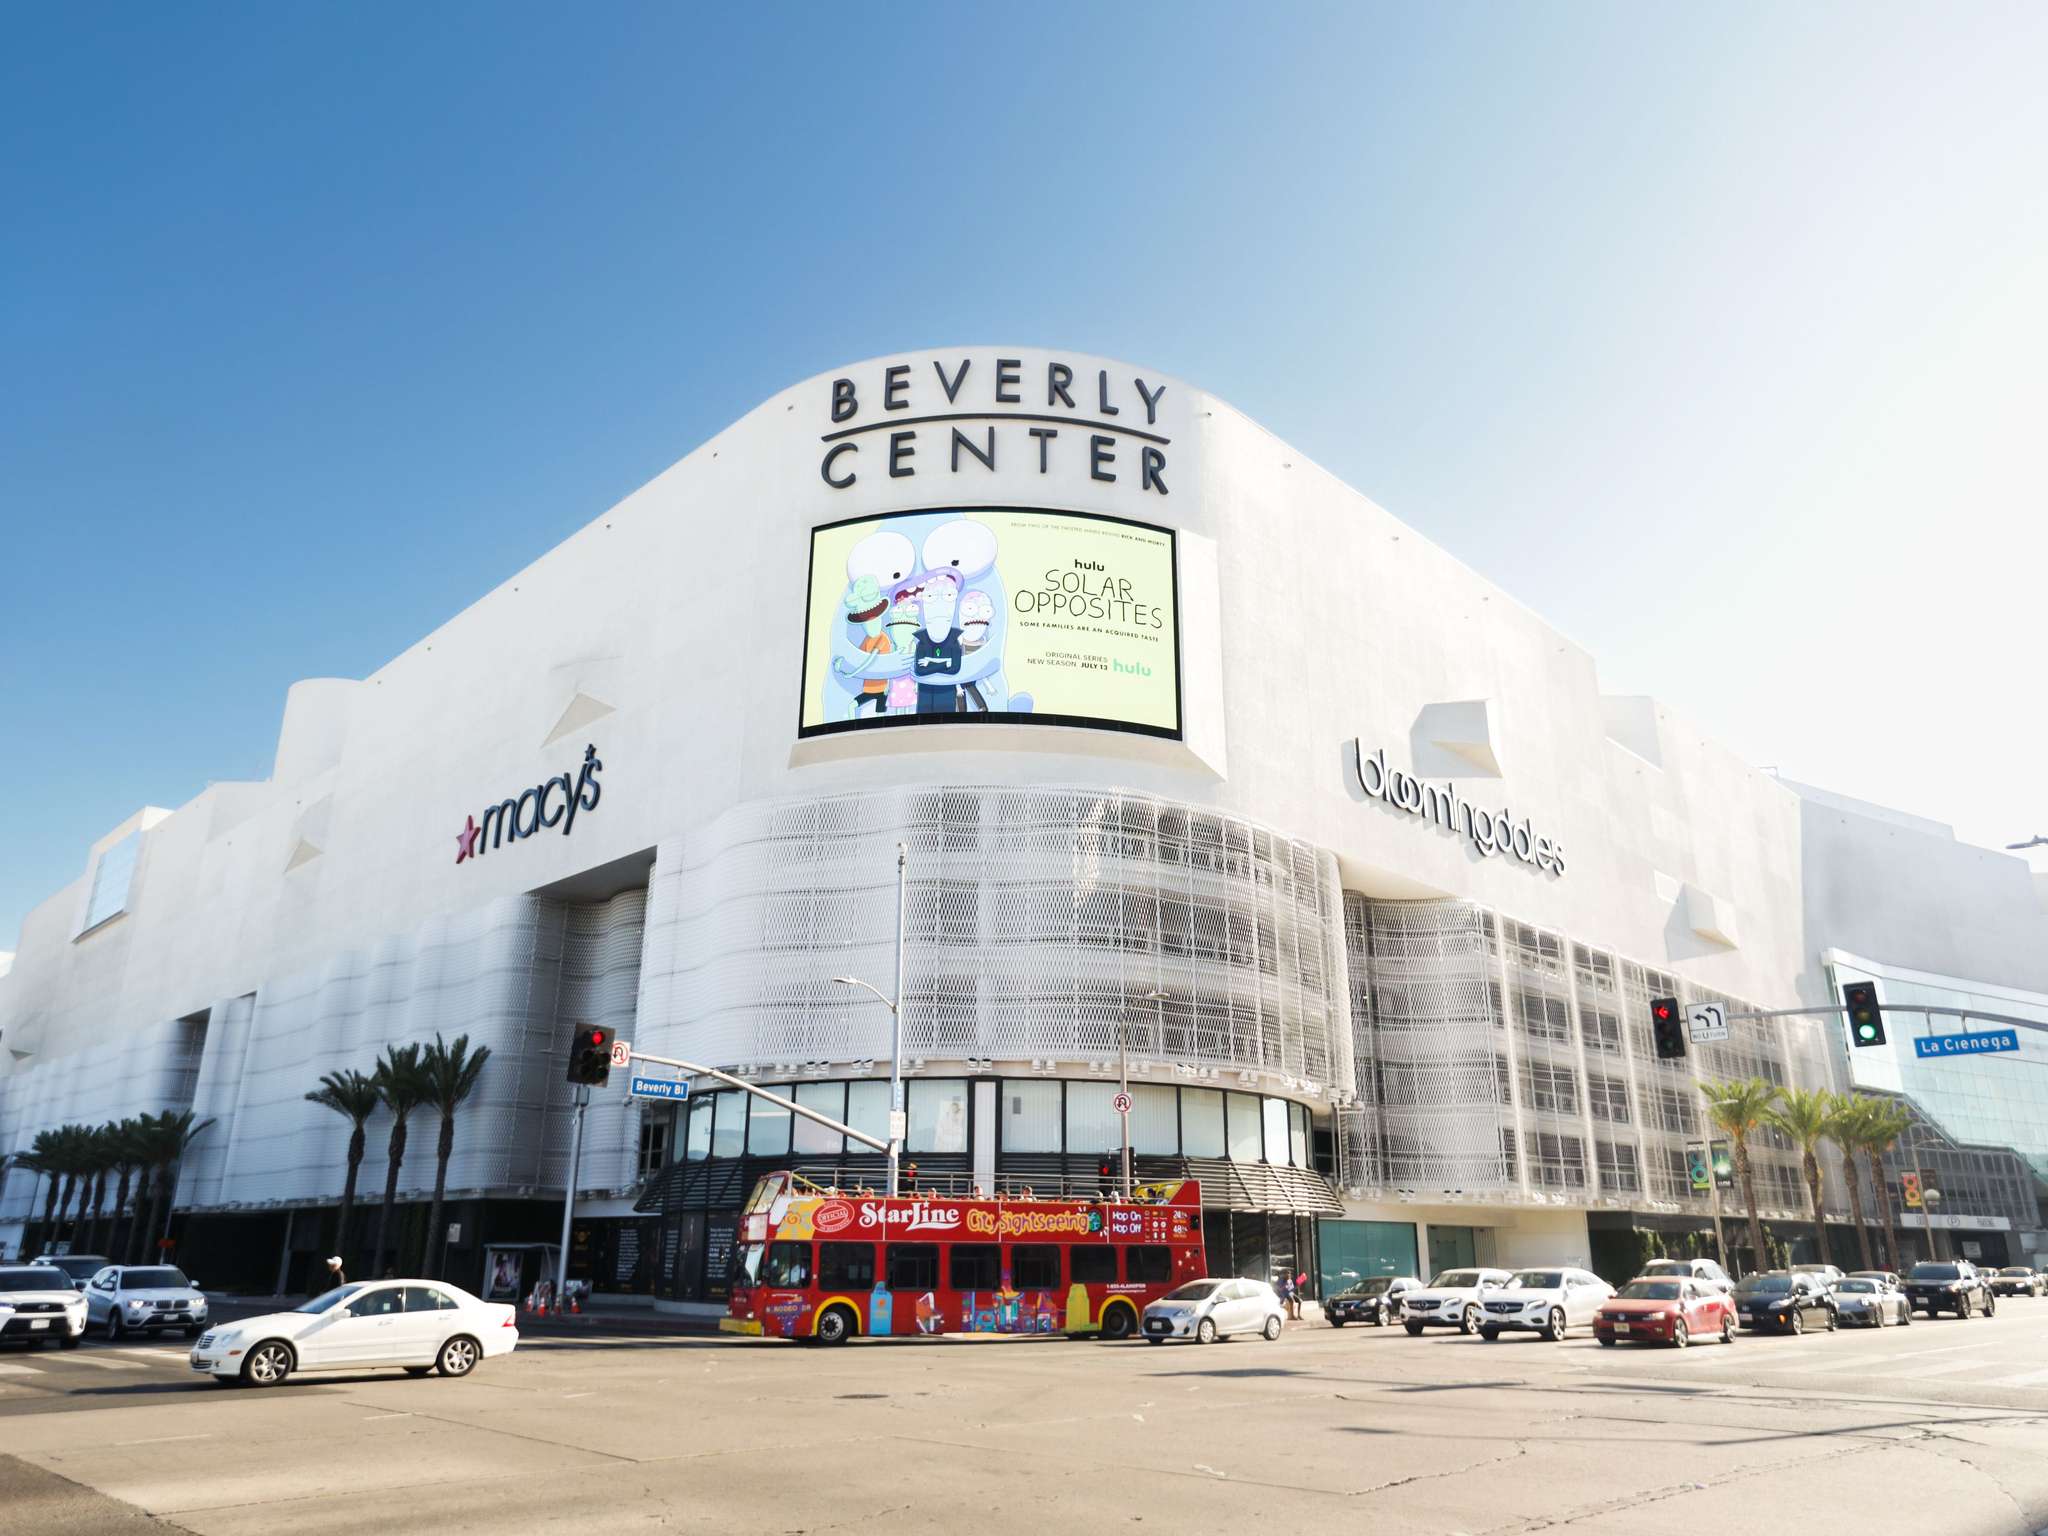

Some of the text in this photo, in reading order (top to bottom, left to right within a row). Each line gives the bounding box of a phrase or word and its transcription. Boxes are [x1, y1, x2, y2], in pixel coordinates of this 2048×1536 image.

[831, 359, 1166, 424] BEVERLY
[821, 426, 1169, 495] CENTER
[1074, 559, 1105, 571] hulu
[1045, 569, 1134, 601] SOLAR
[1015, 590, 1163, 629] OPPOSITES
[1105, 628, 1139, 639] ACQUIRED
[1141, 634, 1159, 642] TASTE
[1027, 658, 1044, 666] NEW
[1046, 660, 1077, 668] SEASON
[1080, 662, 1098, 670] JULY
[1045, 651, 1109, 663] ORIGINAL SERIES
[1112, 658, 1152, 677] hulu
[1921, 1035, 2011, 1053] La Cienega
[636, 1080, 684, 1096] Beverly Bl
[819, 1209, 848, 1222] OFFICIAL
[1112, 1210, 1141, 1221] Hop On
[1112, 1223, 1142, 1233] Hop Off
[774, 1305, 798, 1313] RODEO
